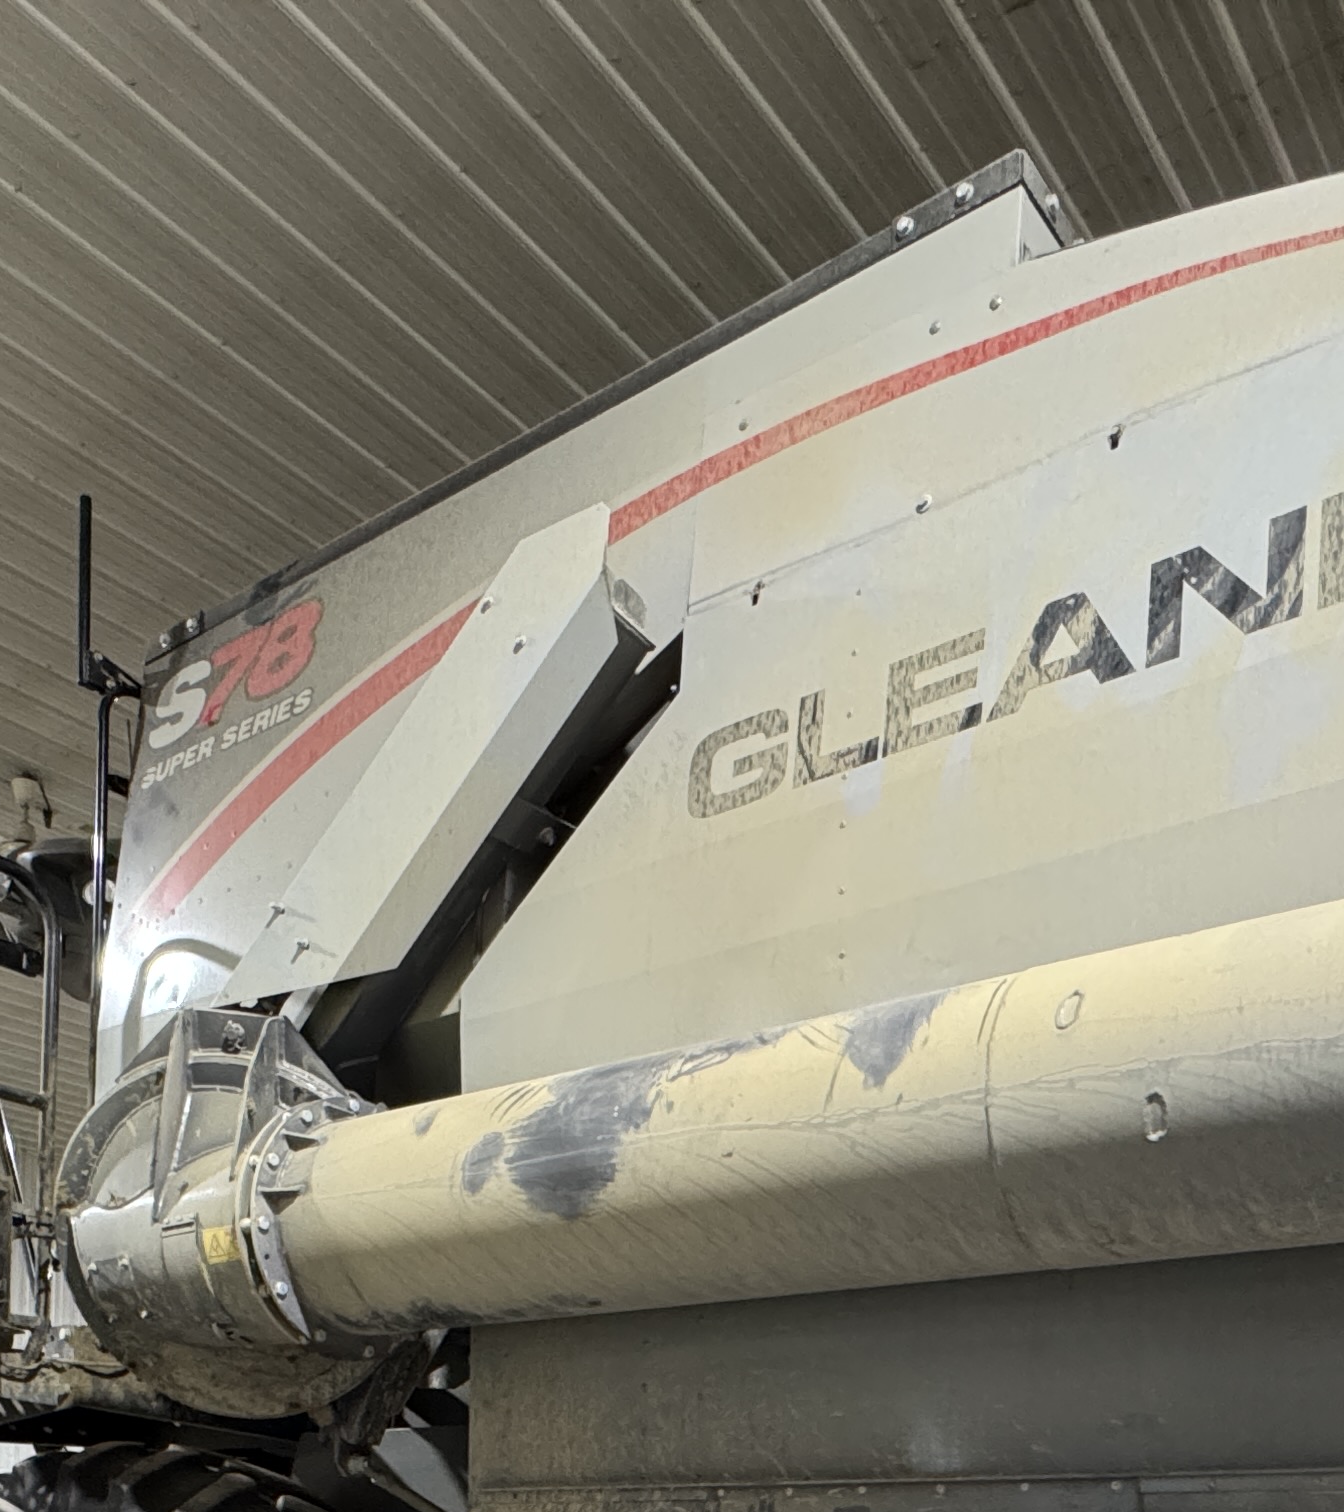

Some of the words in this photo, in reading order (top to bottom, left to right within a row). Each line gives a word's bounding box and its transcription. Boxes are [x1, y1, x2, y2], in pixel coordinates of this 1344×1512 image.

[148, 599, 323, 749] S78
[140, 736, 216, 790] SUPER
[220, 688, 314, 751] SERIES
